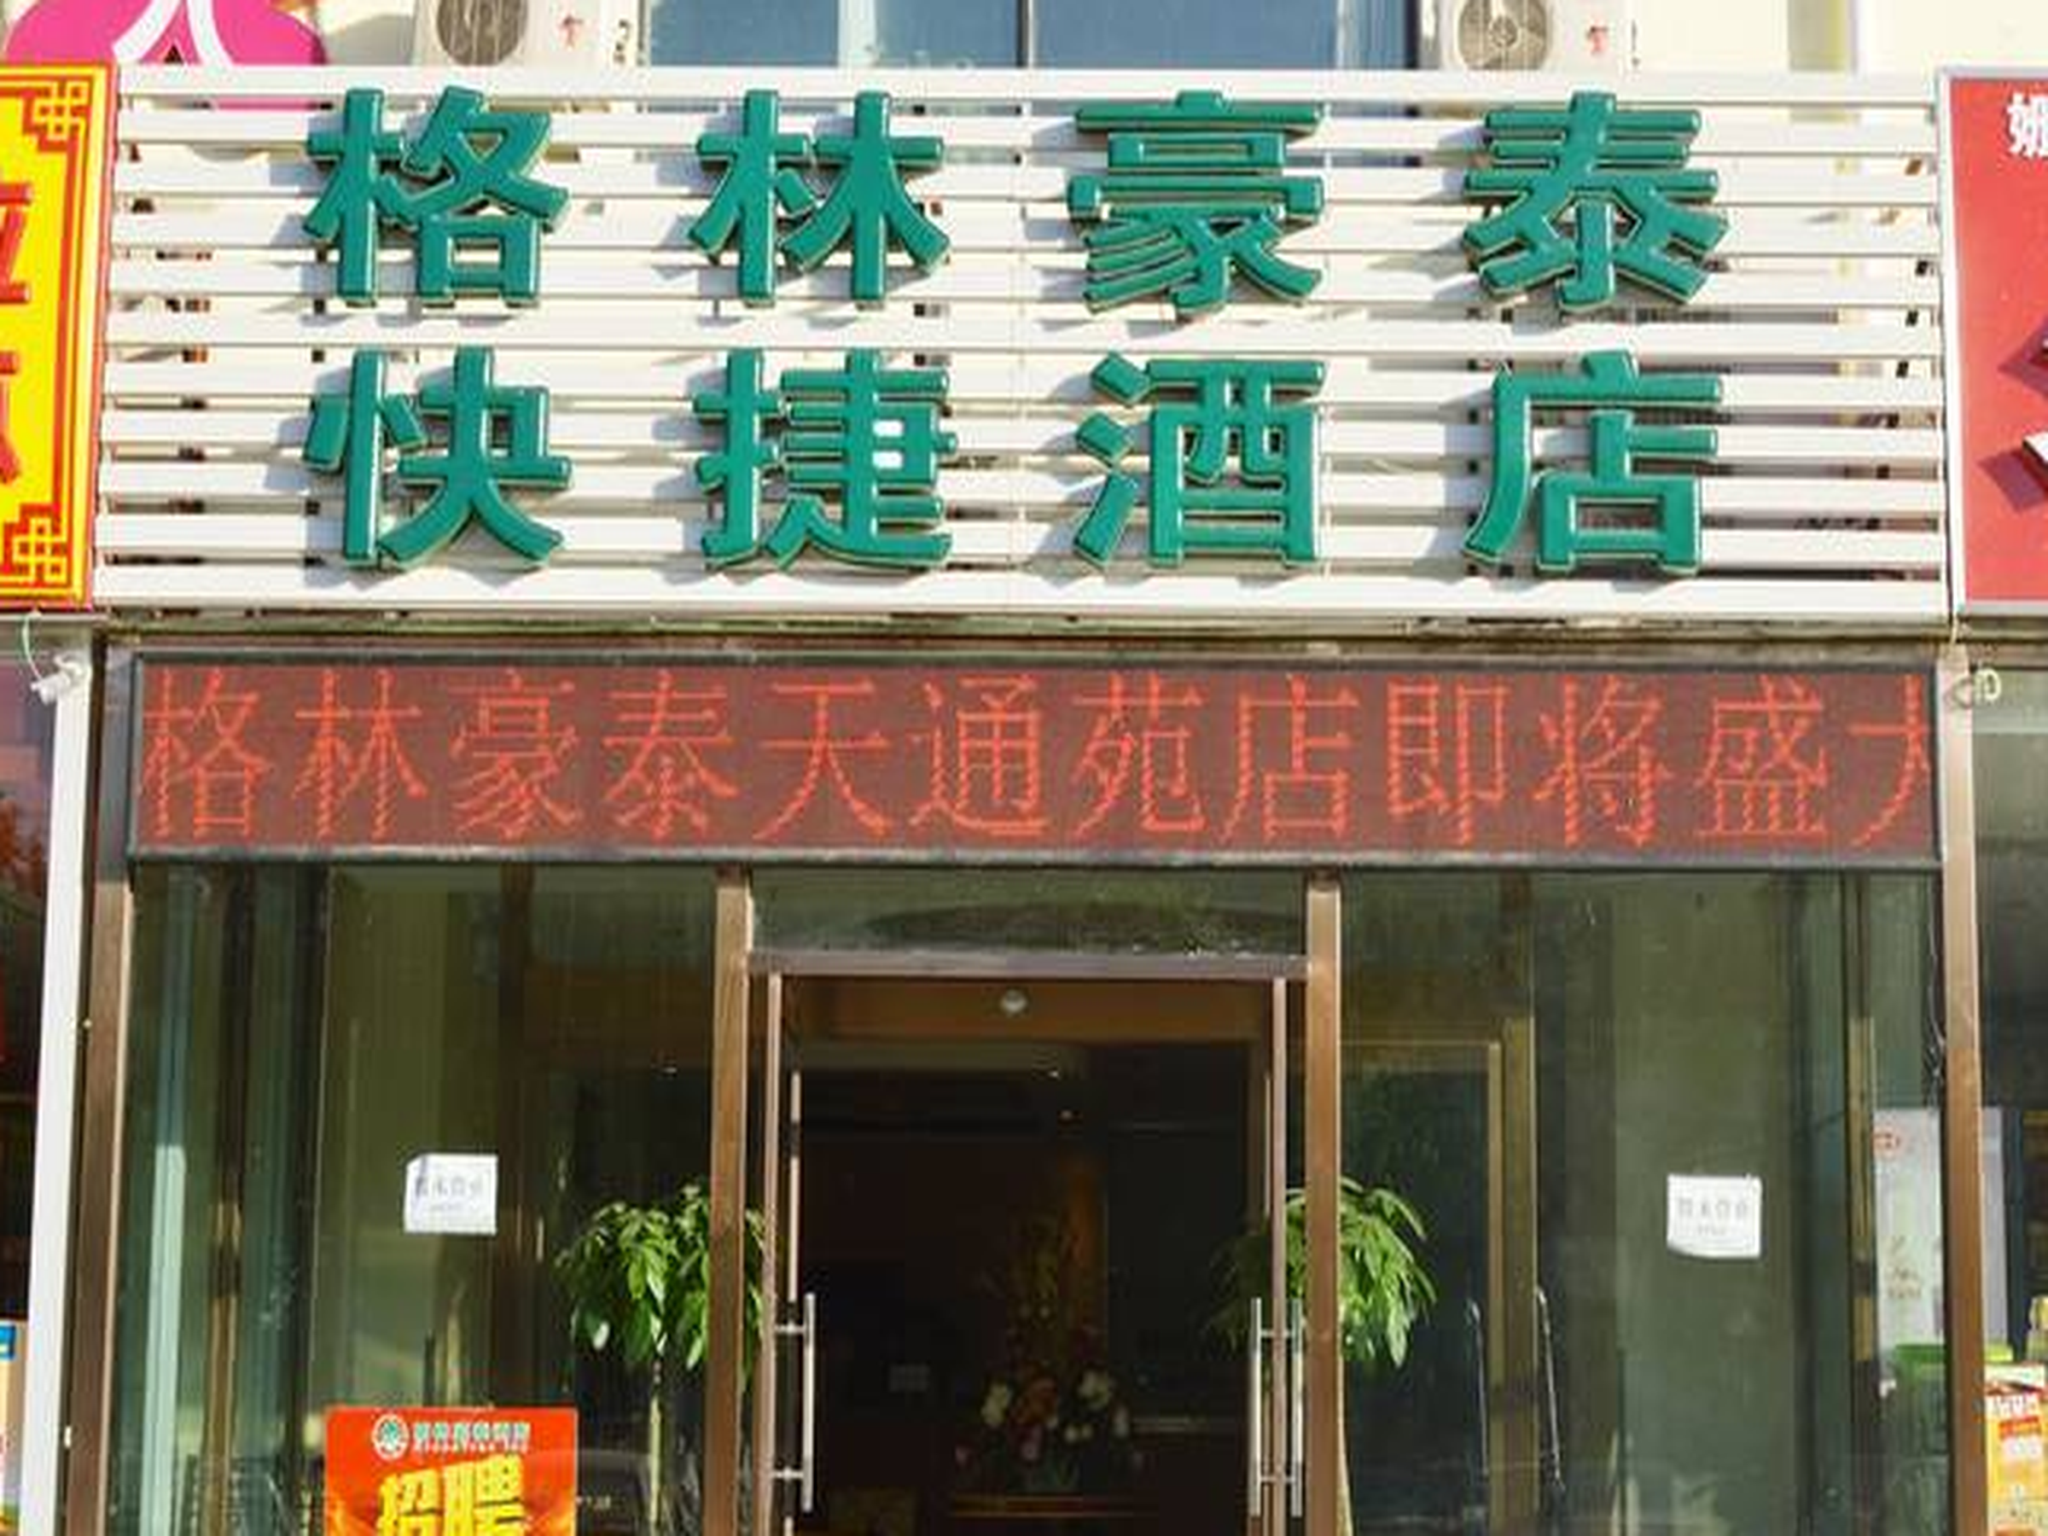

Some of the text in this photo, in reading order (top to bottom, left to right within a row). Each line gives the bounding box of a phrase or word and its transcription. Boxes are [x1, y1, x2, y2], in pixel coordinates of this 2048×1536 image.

[302, 85, 1730, 315] 格林豪泰
[302, 347, 1724, 574] 快捷酒店
